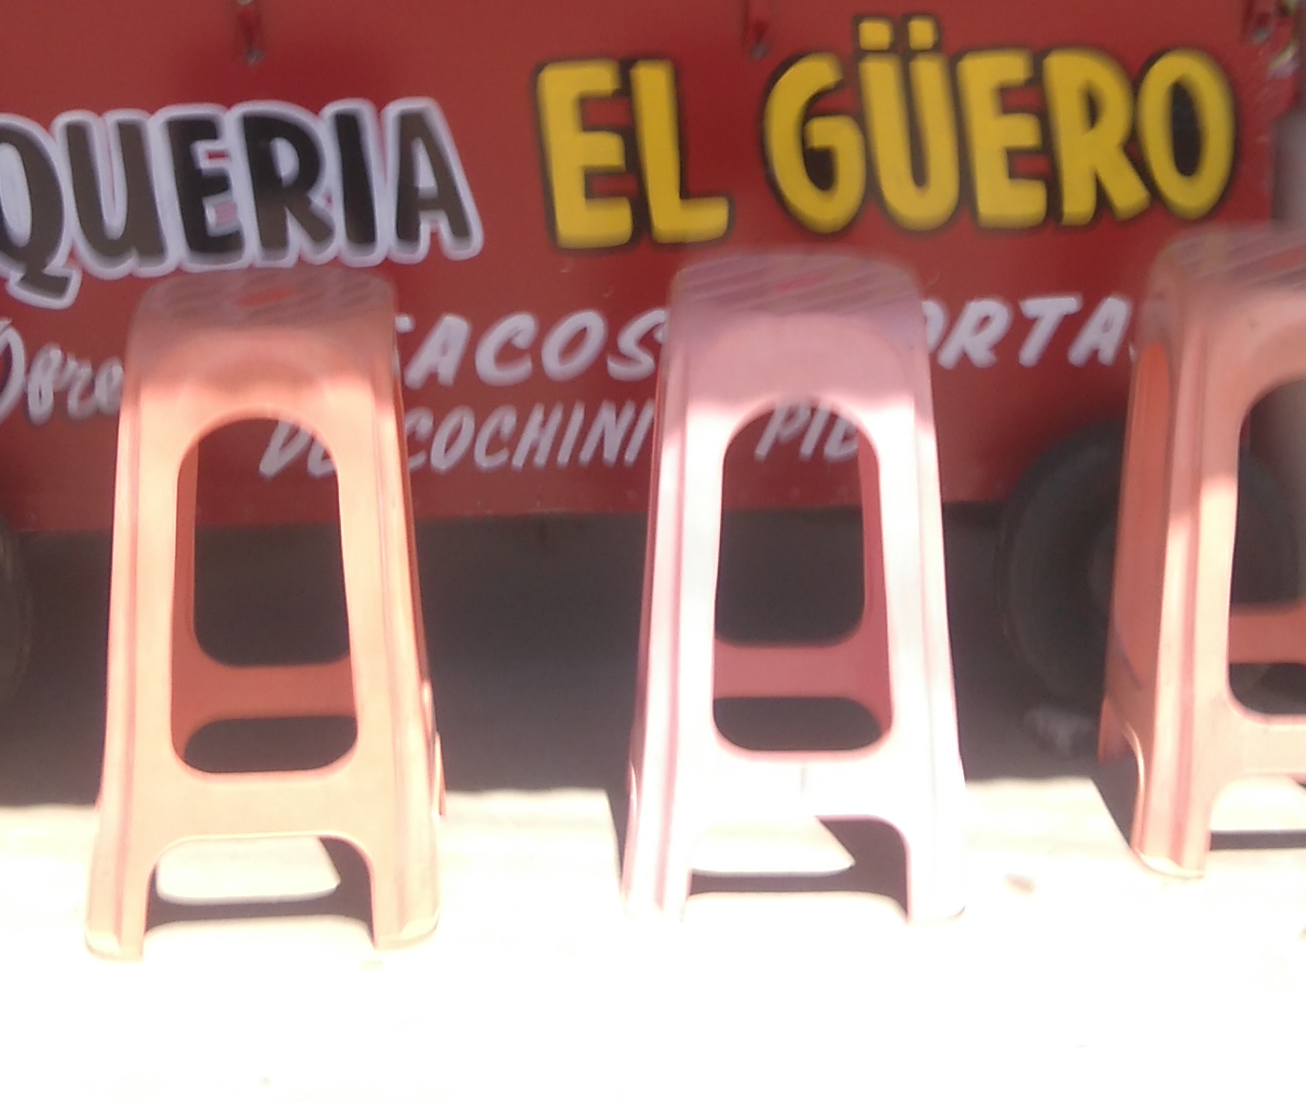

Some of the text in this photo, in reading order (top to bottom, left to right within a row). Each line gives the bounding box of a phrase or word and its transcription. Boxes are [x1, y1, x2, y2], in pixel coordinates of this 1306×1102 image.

[534, 56, 731, 251] EL
[763, 14, 1237, 235] GÜERO
[394, 308, 667, 389] ACOS
[922, 294, 1135, 369] RTA
[405, 401, 653, 476] COCHINI
